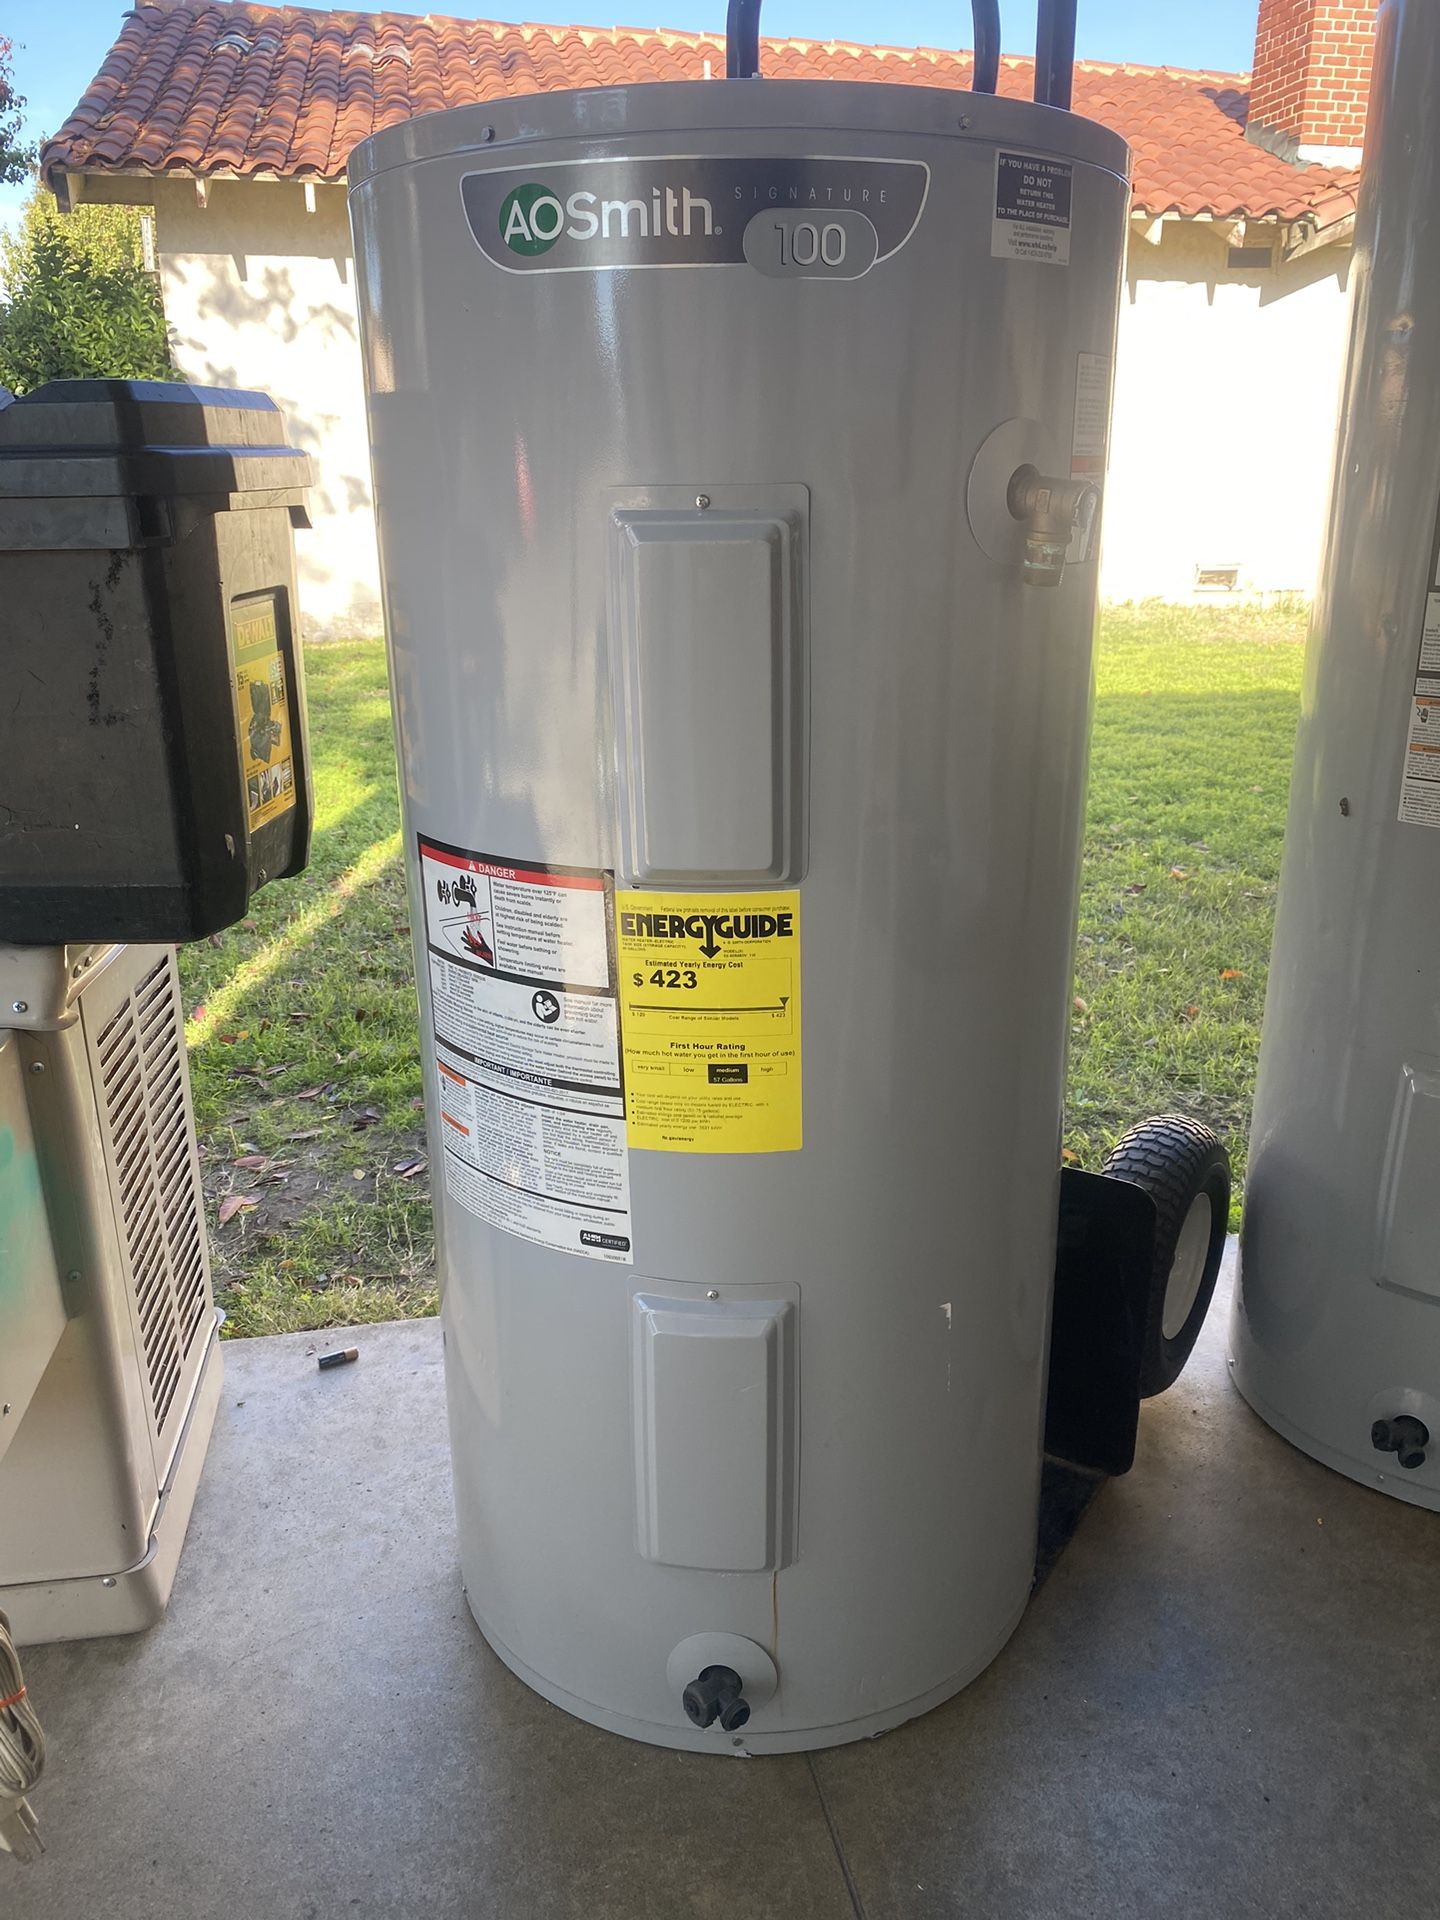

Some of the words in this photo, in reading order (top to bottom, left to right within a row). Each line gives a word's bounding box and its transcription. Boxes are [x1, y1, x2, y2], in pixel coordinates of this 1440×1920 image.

[1008, 159, 1022, 168] YOU
[1023, 161, 1040, 171] HAVE
[1041, 165, 1046, 173] A
[1023, 175, 1035, 185] DO
[1037, 177, 1053, 189] NOT
[735, 187, 886, 203] SIGNATURE
[1020, 188, 1041, 198] RETURN
[1042, 191, 1054, 200] THIS
[1017, 198, 1035, 207] WATER
[1036, 202, 1055, 210] HEATER
[1007, 208, 1018, 216] THE
[1019, 210, 1035, 218] PLACE
[775, 222, 846, 266] 100
[478, 863, 516, 879] DANGER
[505, 883, 531, 893] temperature
[535, 896, 555, 904] instantly
[501, 913, 517, 921] highest
[531, 918, 543, 926] being
[514, 909, 532, 917] disabled
[543, 914, 559, 922] elderly
[621, 912, 793, 940] ENERGYGUIDE
[497, 929, 510, 937] setting
[511, 932, 536, 941] temperature
[533, 946, 551, 954] bathing
[499, 955, 523, 965] Temperature
[524, 961, 541, 970] limiting
[680, 961, 700, 969] Yearly
[703, 961, 726, 970] Energy
[633, 973, 643, 987] $
[650, 970, 697, 989] 423
[717, 1043, 745, 1051] Rating
[780, 1049, 795, 1057] use)
[474, 1057, 505, 1074] IMPORTANT
[510, 1070, 552, 1086] IMPORTANTE
[543, 1149, 561, 1157] NOTICE
[602, 1238, 626, 1246] CERTIFIED
